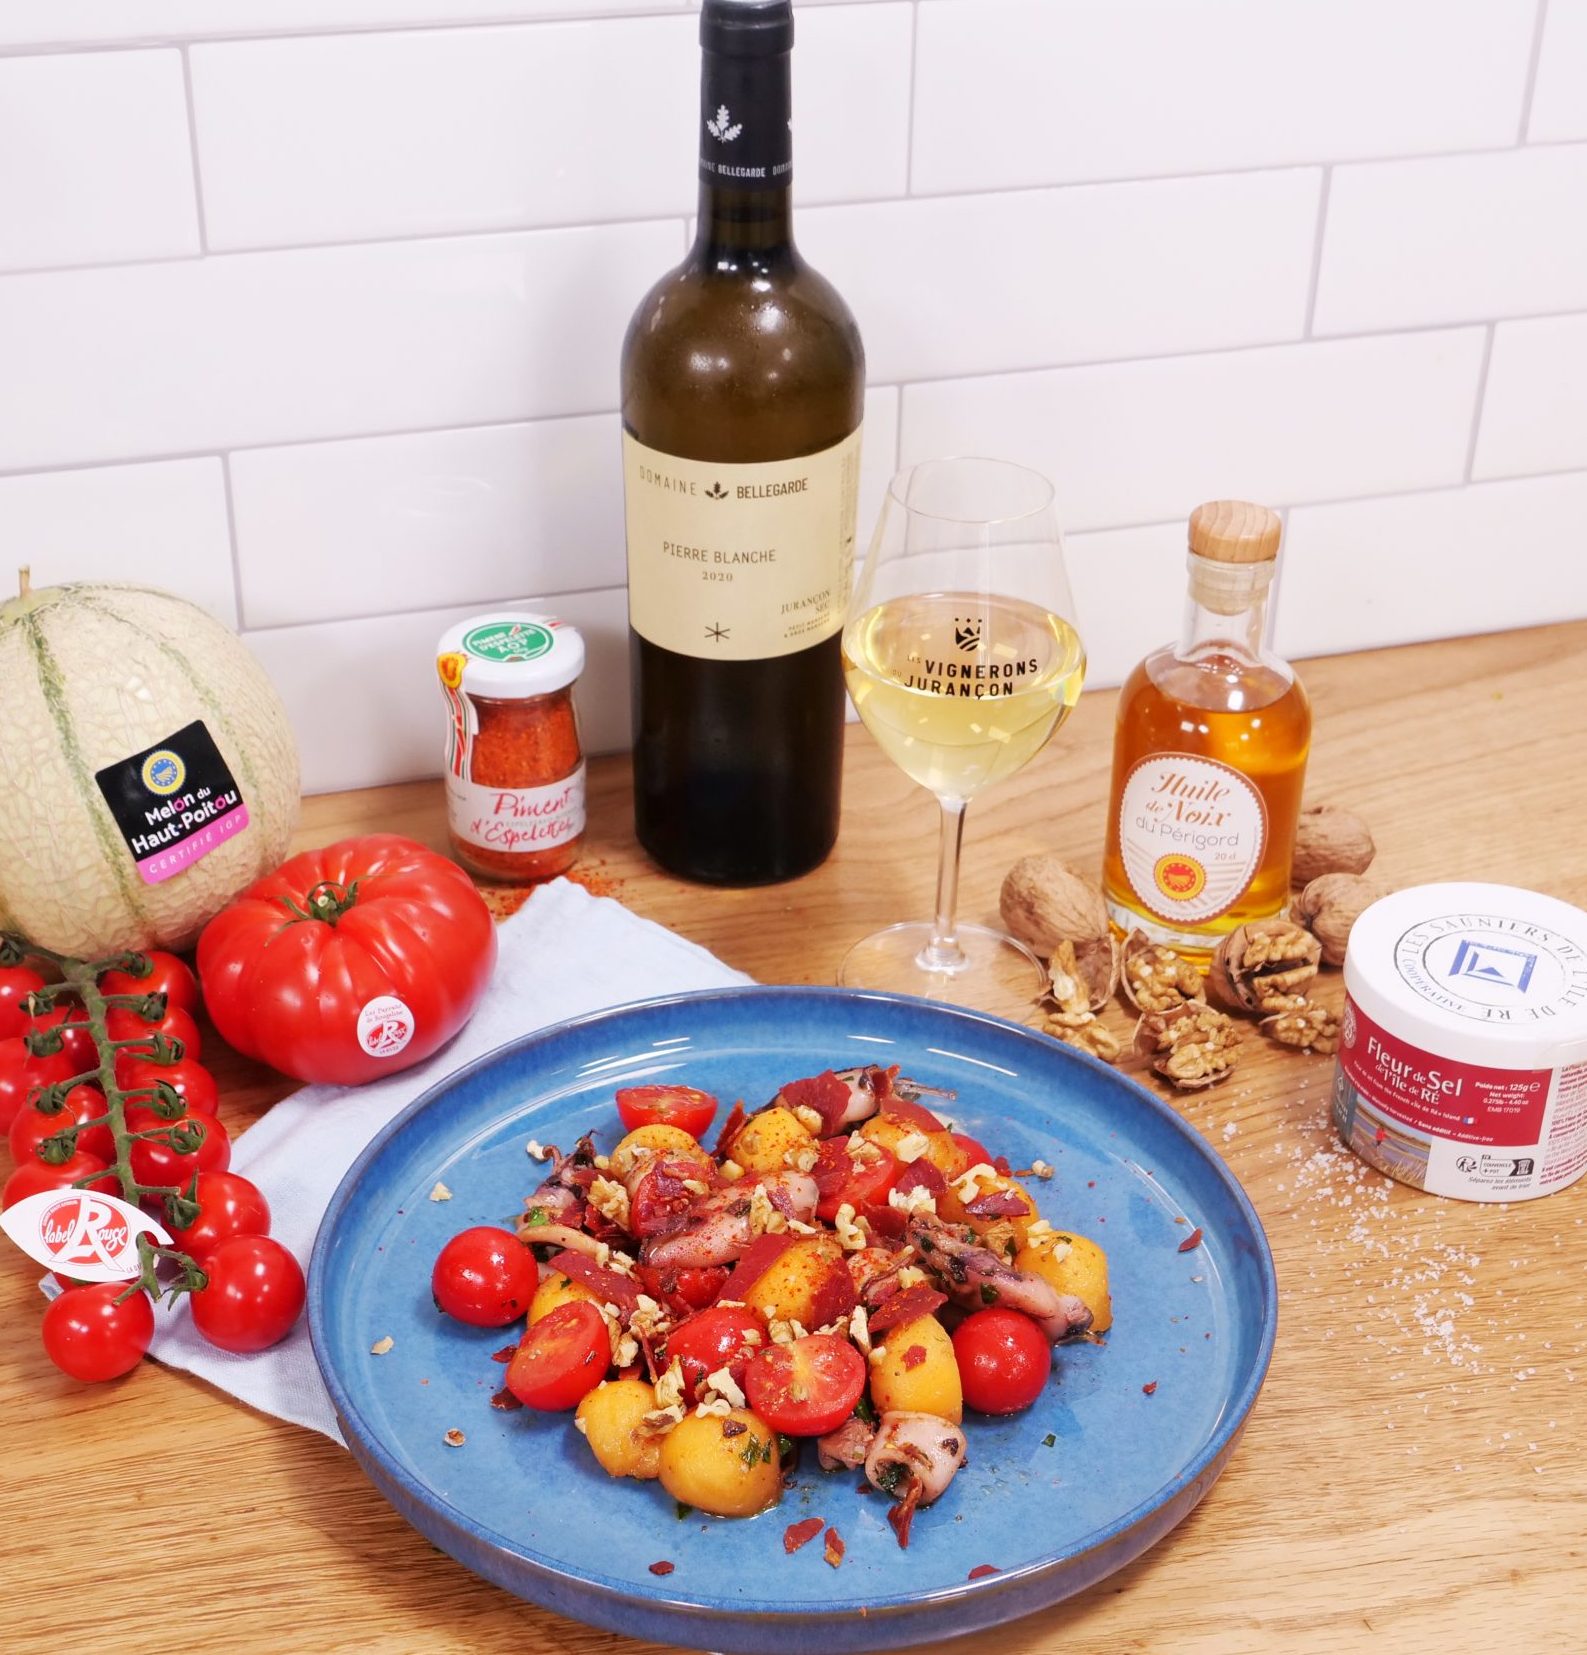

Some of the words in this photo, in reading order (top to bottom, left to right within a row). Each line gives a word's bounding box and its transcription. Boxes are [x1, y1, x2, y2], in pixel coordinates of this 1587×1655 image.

[718, 163, 766, 178] BELLEGARDE
[639, 465, 697, 496] DOMAINE
[736, 478, 809, 500] BELLEGARDE
[662, 541, 708, 562] PIERRE
[714, 549, 777, 565] BLANCHE
[702, 571, 734, 582] 2020
[925, 658, 1038, 680] VIGNERONS
[904, 675, 1013, 700] JURANÇON
[490, 786, 576, 817] Piment
[1151, 773, 1231, 802] Huile
[144, 792, 196, 827] Melon
[196, 786, 212, 801] du
[1145, 800, 1164, 813] de
[1154, 800, 1231, 827] Noix
[131, 789, 238, 854] Haut-Poitou
[1135, 815, 1155, 834] du
[1160, 823, 1239, 851] Périgord
[1402, 930, 1429, 954] LES
[1429, 917, 1553, 942] SAUNIERS
[1557, 944, 1584, 962] DE
[1368, 1036, 1413, 1078] Fleur
[1413, 1072, 1426, 1084] de
[1426, 1071, 1463, 1097] Sel
[1375, 1064, 1385, 1073] de
[1408, 1086, 1419, 1096] de
[1420, 1090, 1440, 1105] RÉ
[1509, 1083, 1529, 1093] 125g
[43, 1219, 76, 1244] label
